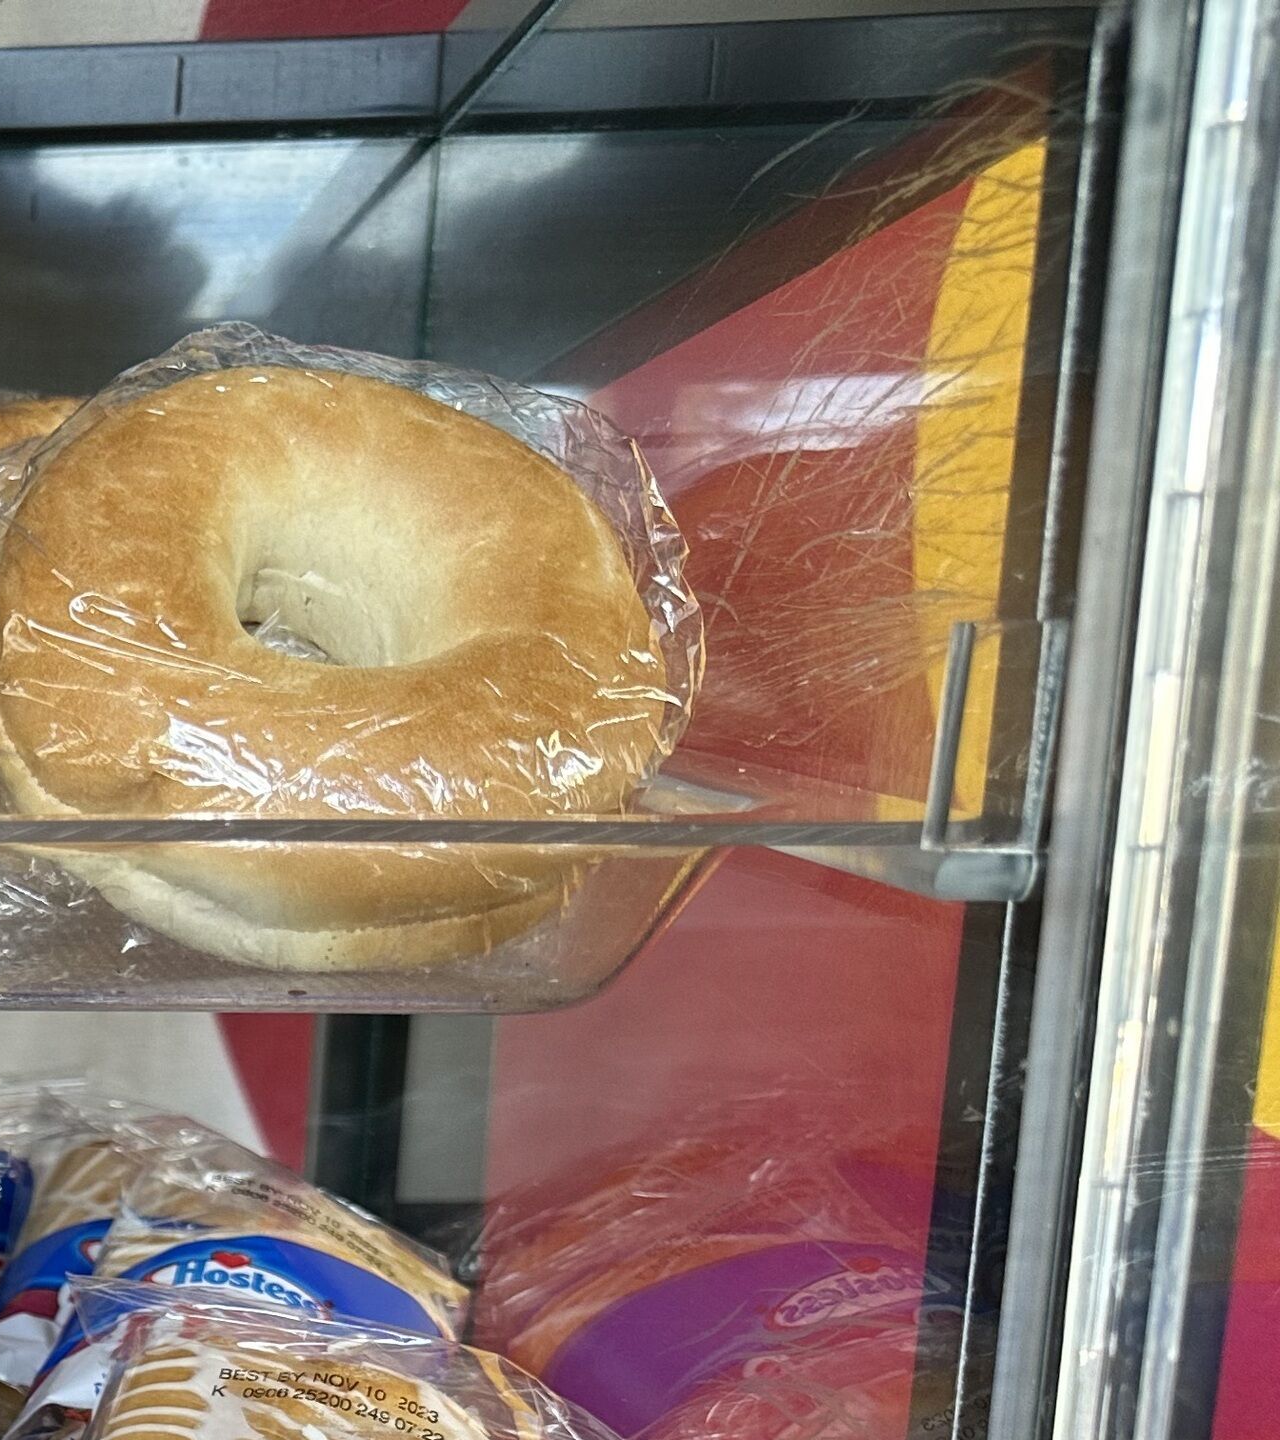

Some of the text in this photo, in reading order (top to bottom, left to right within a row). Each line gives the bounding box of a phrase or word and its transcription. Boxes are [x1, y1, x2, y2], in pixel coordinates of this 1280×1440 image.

[211, 1385, 228, 1398] K
[292, 1387, 353, 1413] 25200
[354, 1403, 391, 1425] 249
[219, 1367, 439, 1425] BEST BY NOV 10 2023
